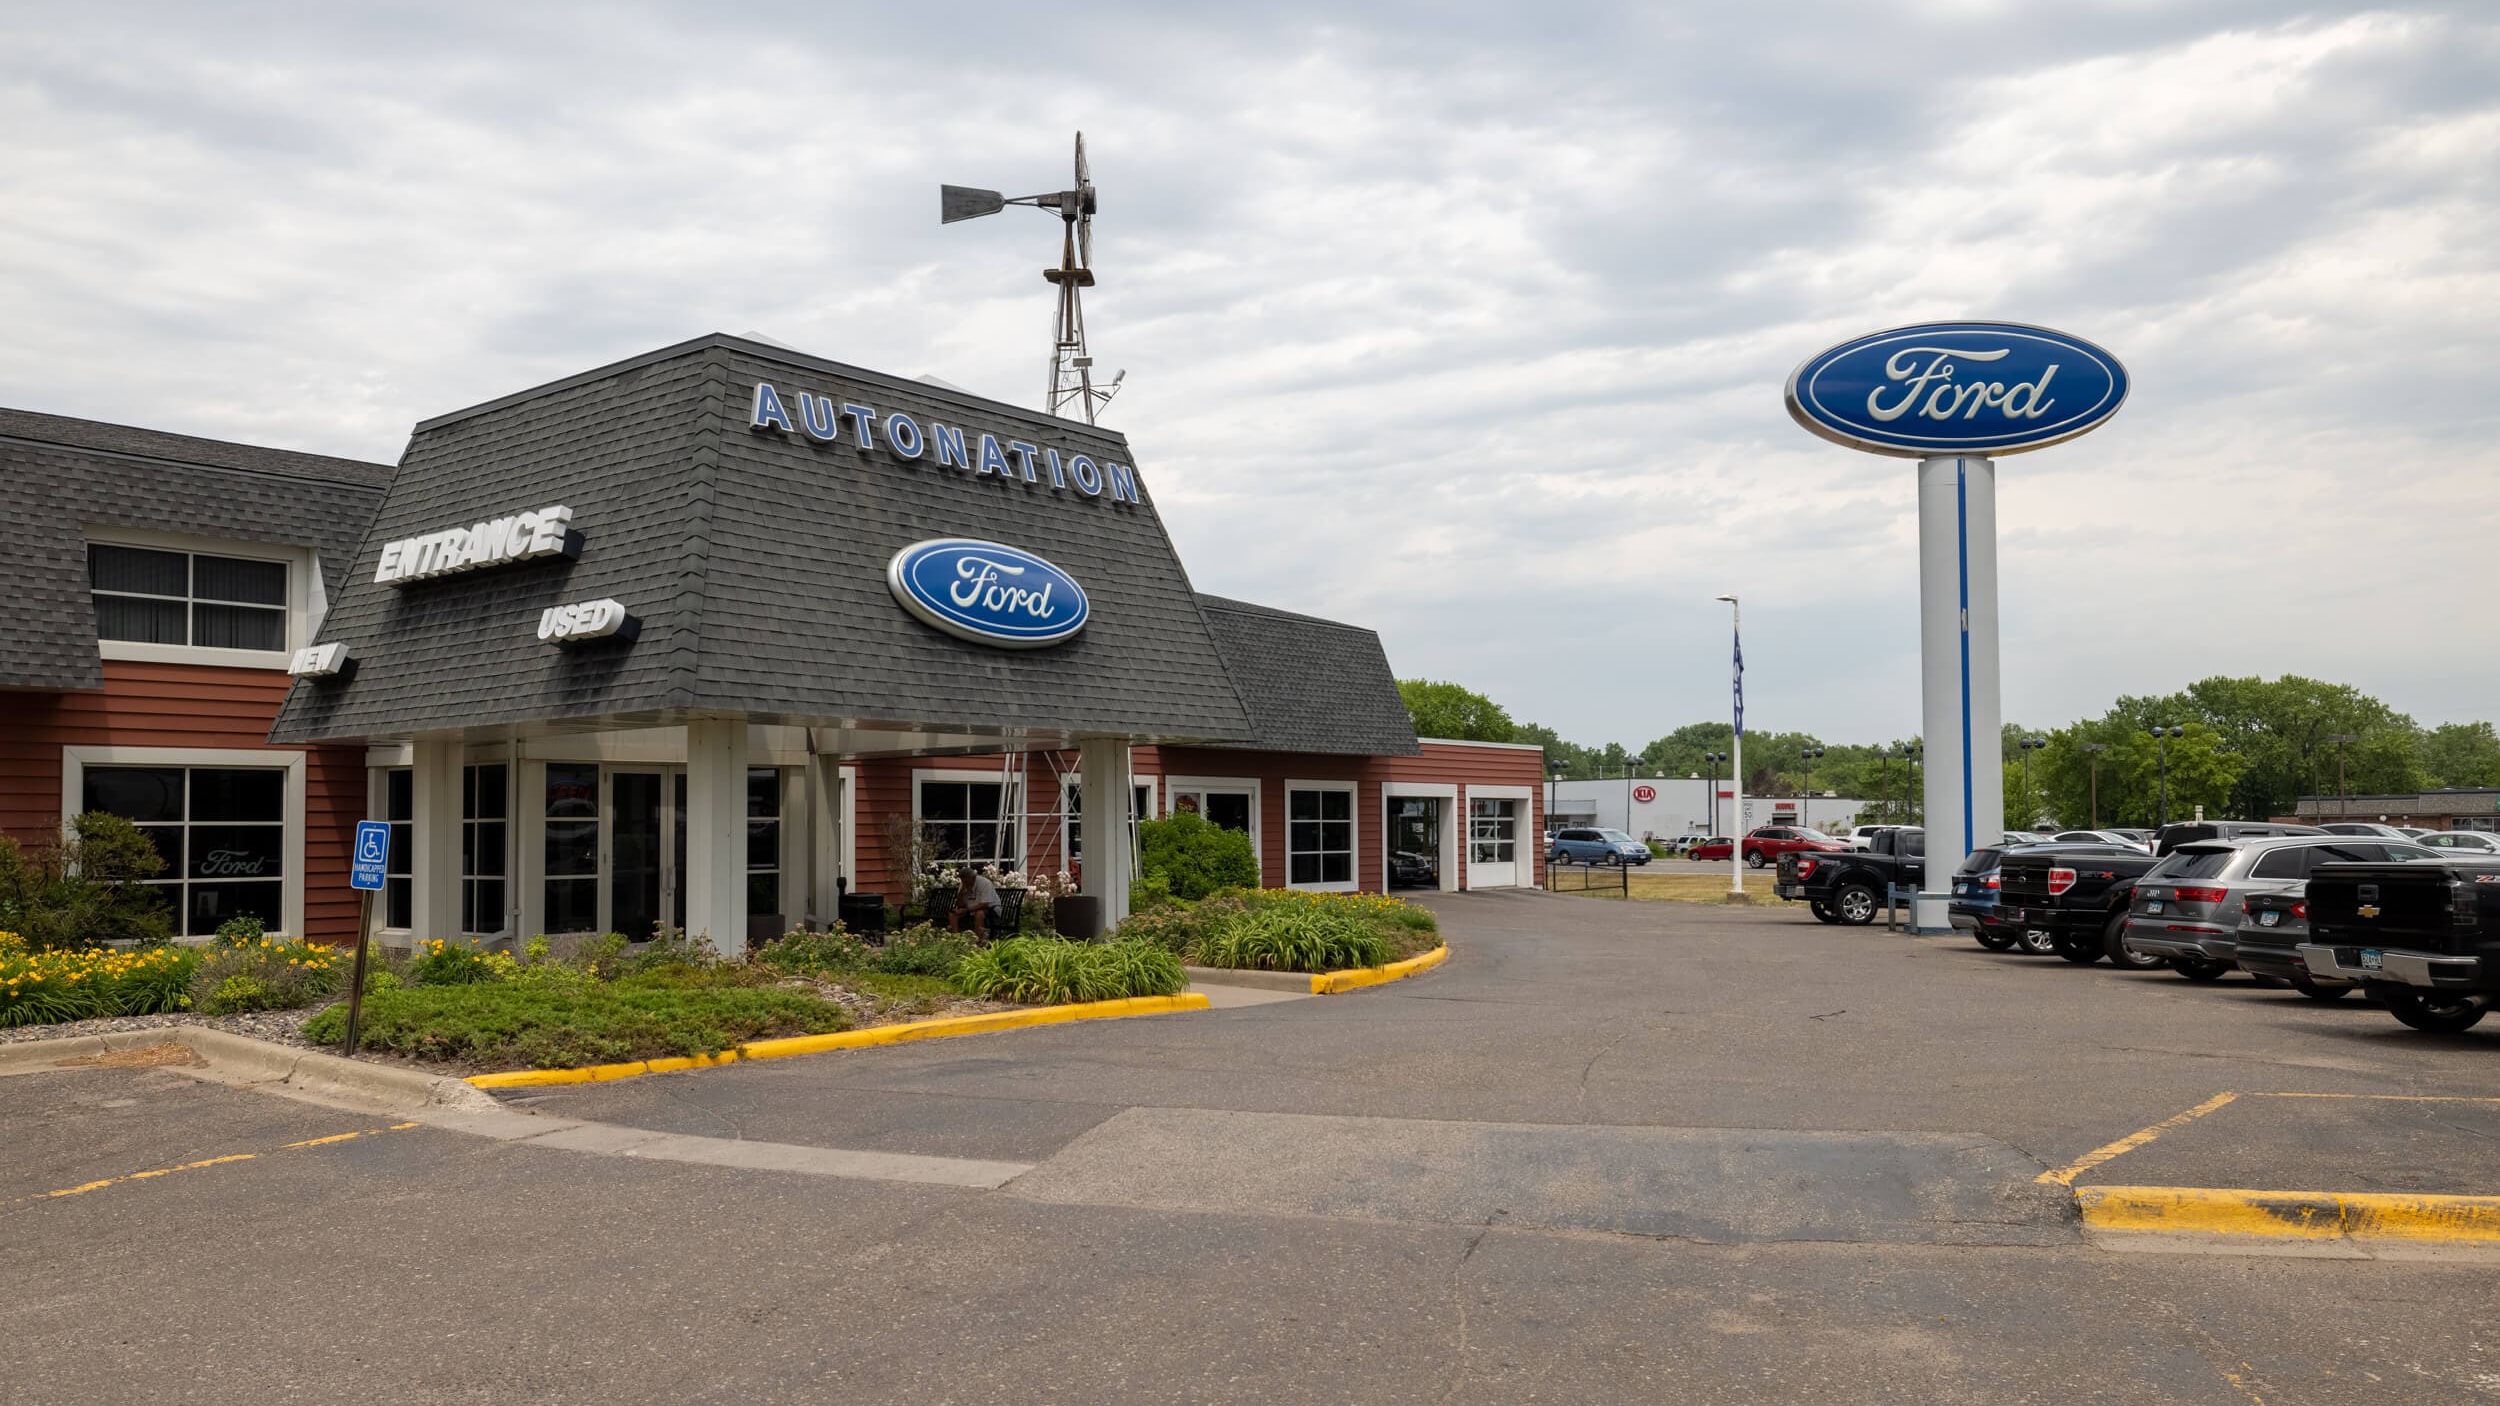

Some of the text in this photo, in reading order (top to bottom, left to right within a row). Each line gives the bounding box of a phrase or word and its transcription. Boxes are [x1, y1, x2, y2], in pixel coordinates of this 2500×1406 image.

[1867, 346, 2060, 422] Ford
[749, 382, 1140, 504] AUTONATION
[374, 504, 574, 584] ENTRANCE
[949, 556, 1055, 619] Ford
[537, 598, 622, 643] USED
[1636, 788, 1653, 800] KIA
[200, 850, 265, 875] Ford
[354, 863, 385, 873] HANDICAPPED
[358, 873, 379, 882] PARKING
